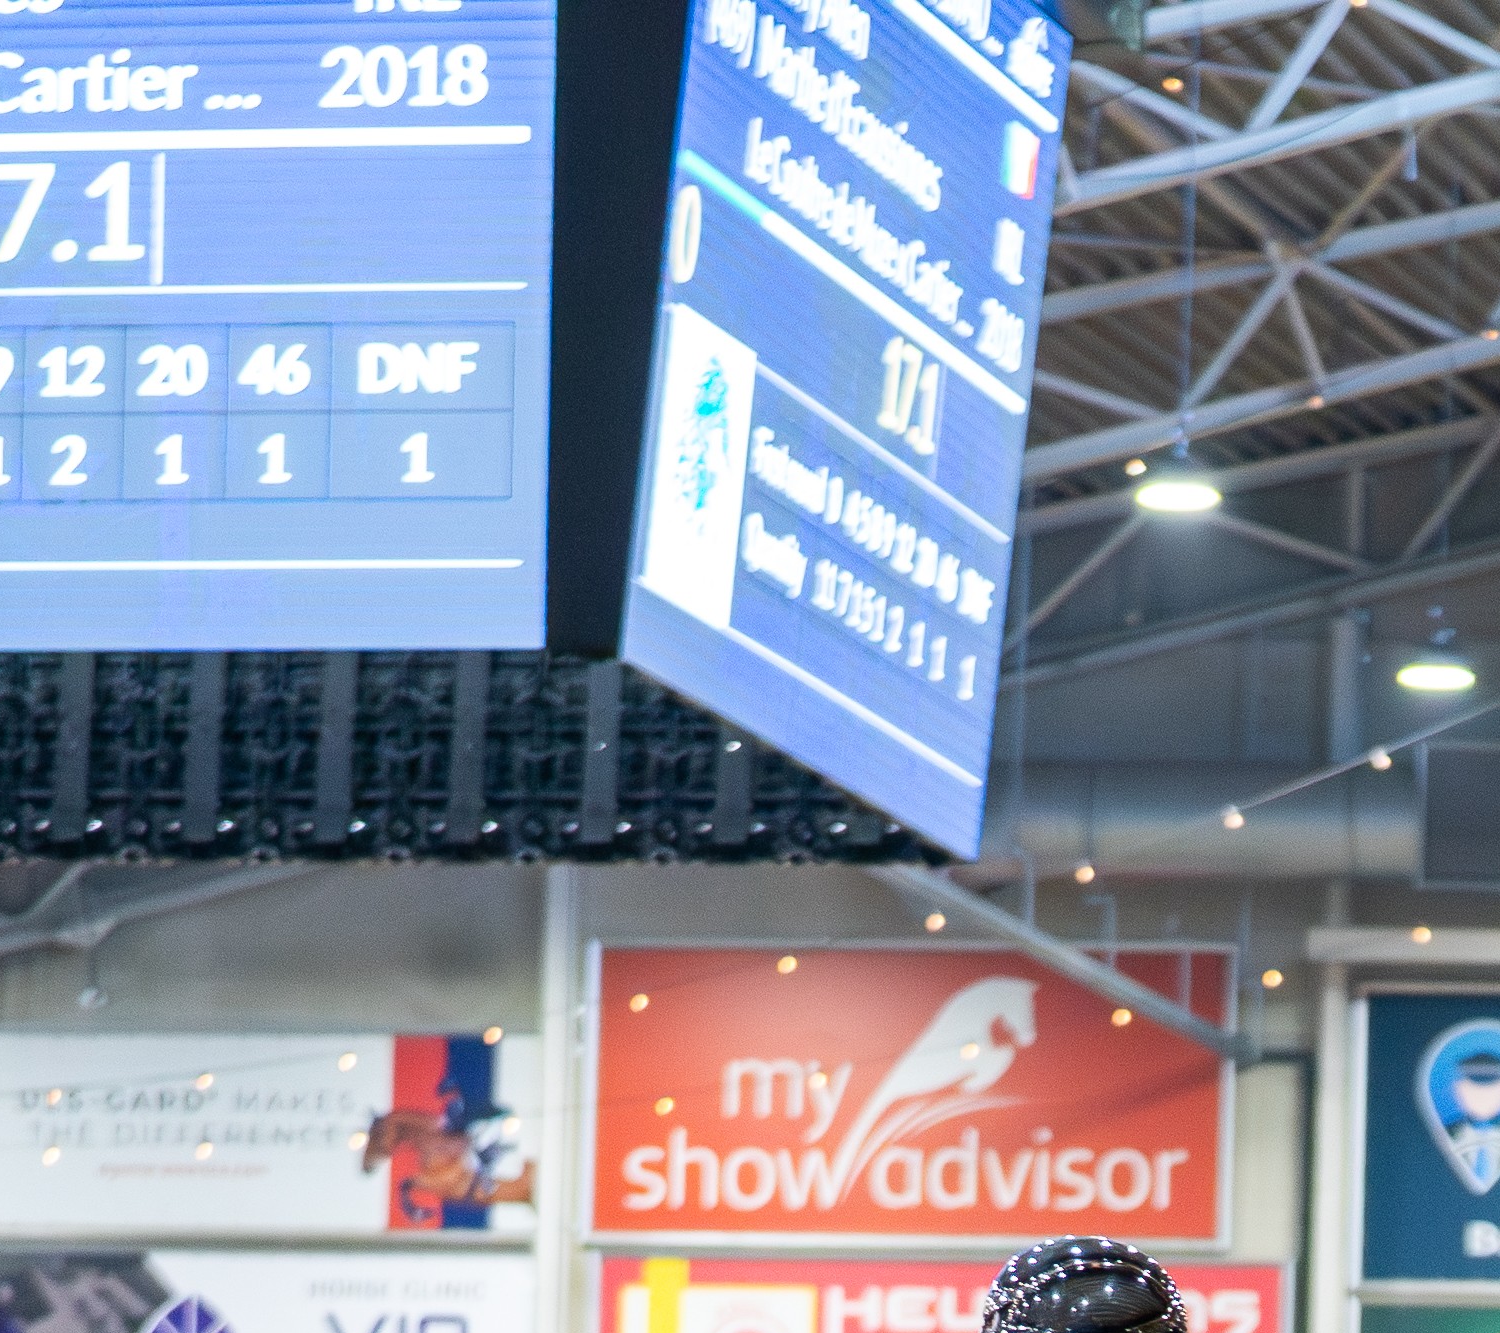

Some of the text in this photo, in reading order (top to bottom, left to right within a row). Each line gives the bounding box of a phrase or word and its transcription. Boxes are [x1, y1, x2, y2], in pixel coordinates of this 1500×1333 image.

[318, 43, 490, 109] 2018
[670, 184, 702, 284] 0
[36, 345, 106, 398] 12
[136, 344, 210, 397] 20
[236, 343, 312, 396] 46
[356, 341, 481, 394] DNF
[49, 434, 89, 487] 2
[153, 434, 190, 486] 1
[256, 433, 293, 485] 1
[399, 432, 436, 484] 1
[721, 1057, 854, 1144] my
[28, 1120, 98, 1148] THE
[621, 1126, 1190, 1213] show advisor
